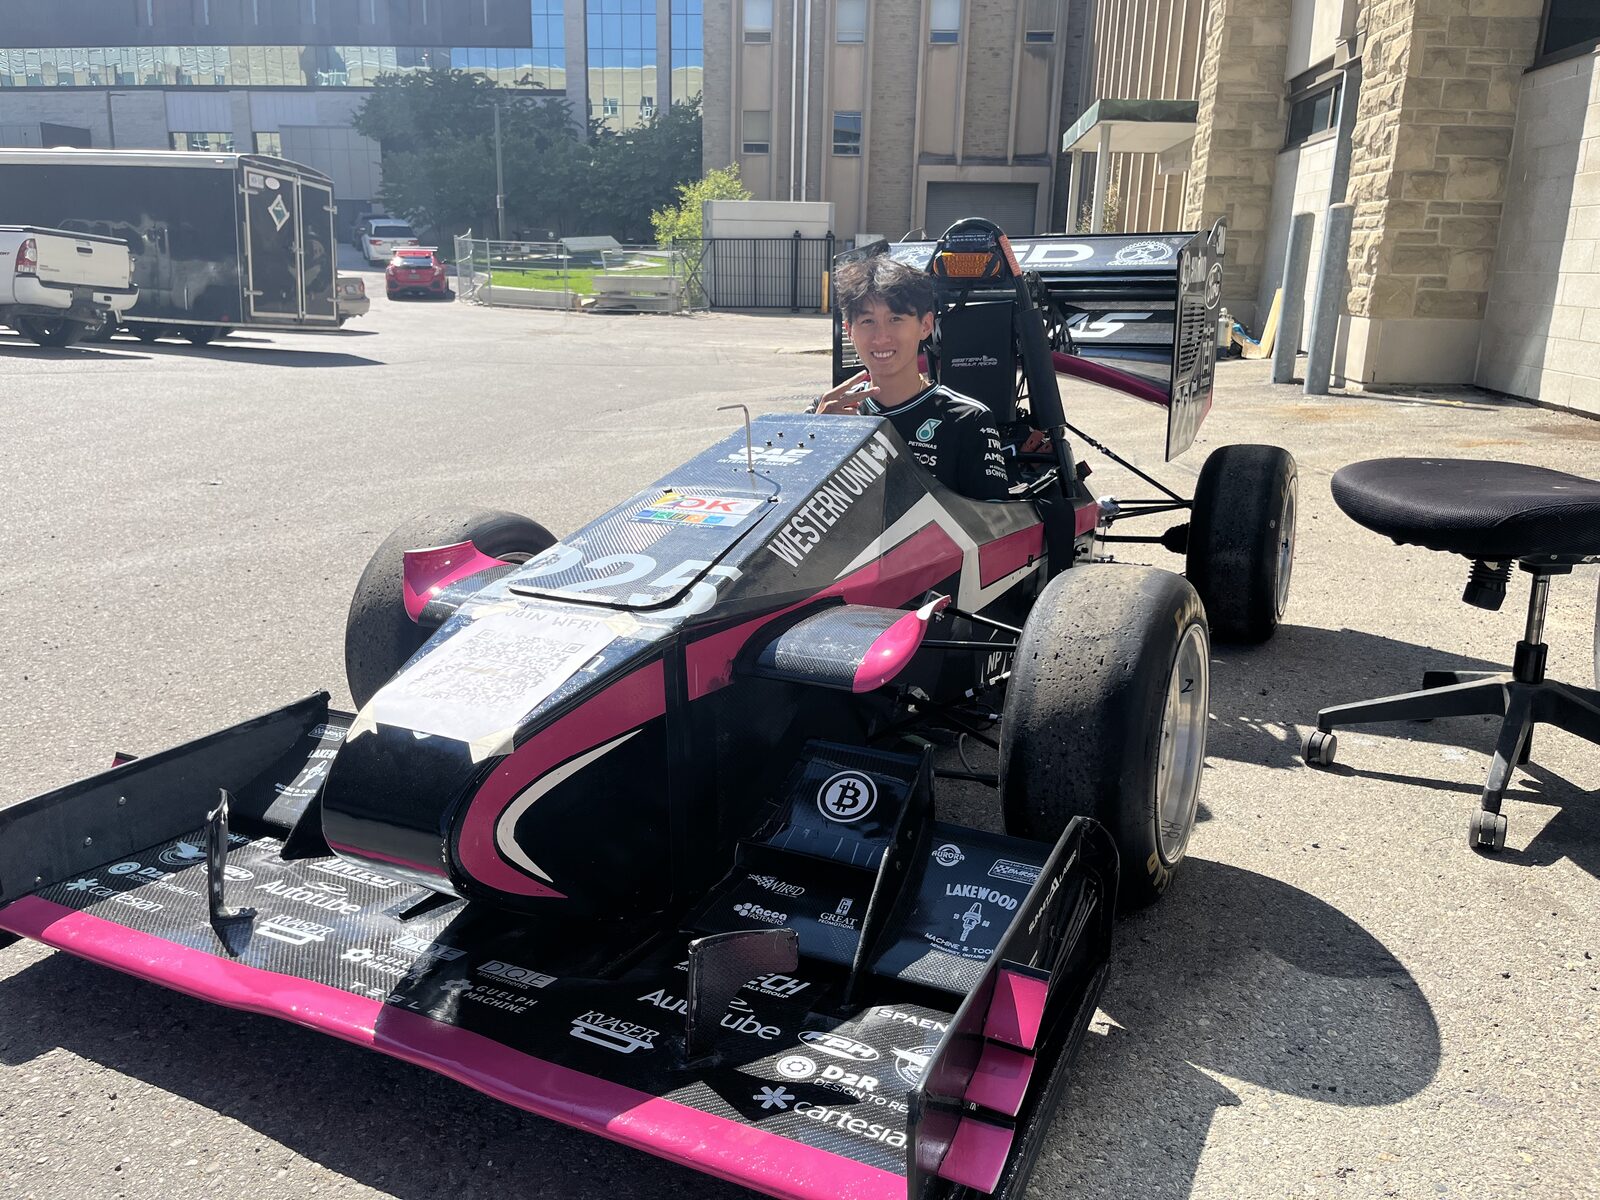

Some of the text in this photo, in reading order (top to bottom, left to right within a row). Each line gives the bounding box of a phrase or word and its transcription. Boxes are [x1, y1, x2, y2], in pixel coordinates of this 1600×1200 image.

[728, 446, 814, 463] SAE
[908, 440, 938, 450] PETRONAS
[767, 457, 877, 568] WESTERN UNI
[476, 544, 743, 618] 225
[505, 609, 548, 622] JOIN
[931, 849, 966, 861] AURORA
[138, 866, 176, 882] D2R
[89, 886, 164, 913] cartesian
[254, 879, 362, 915] Autotube
[946, 884, 1018, 911] LAKEWOOD
[268, 913, 337, 936] KVASER
[747, 912, 784, 926] FASTENERS
[818, 918, 855, 930] PROMOTIONS
[820, 912, 858, 926] GREAT
[925, 933, 960, 950] MACHINE
[962, 952, 986, 960] ONTARIO
[477, 971, 530, 990] instruments
[480, 961, 552, 988] DQE
[463, 991, 527, 1015] MACHINE
[476, 985, 539, 1008] GUELPH
[760, 988, 789, 999] GROUP
[577, 1010, 660, 1043] KVASER
[820, 1064, 879, 1092] D2R
[813, 1077, 866, 1099] DESIGN
[868, 1093, 887, 1105] TO
[793, 1101, 909, 1149] cartesia
